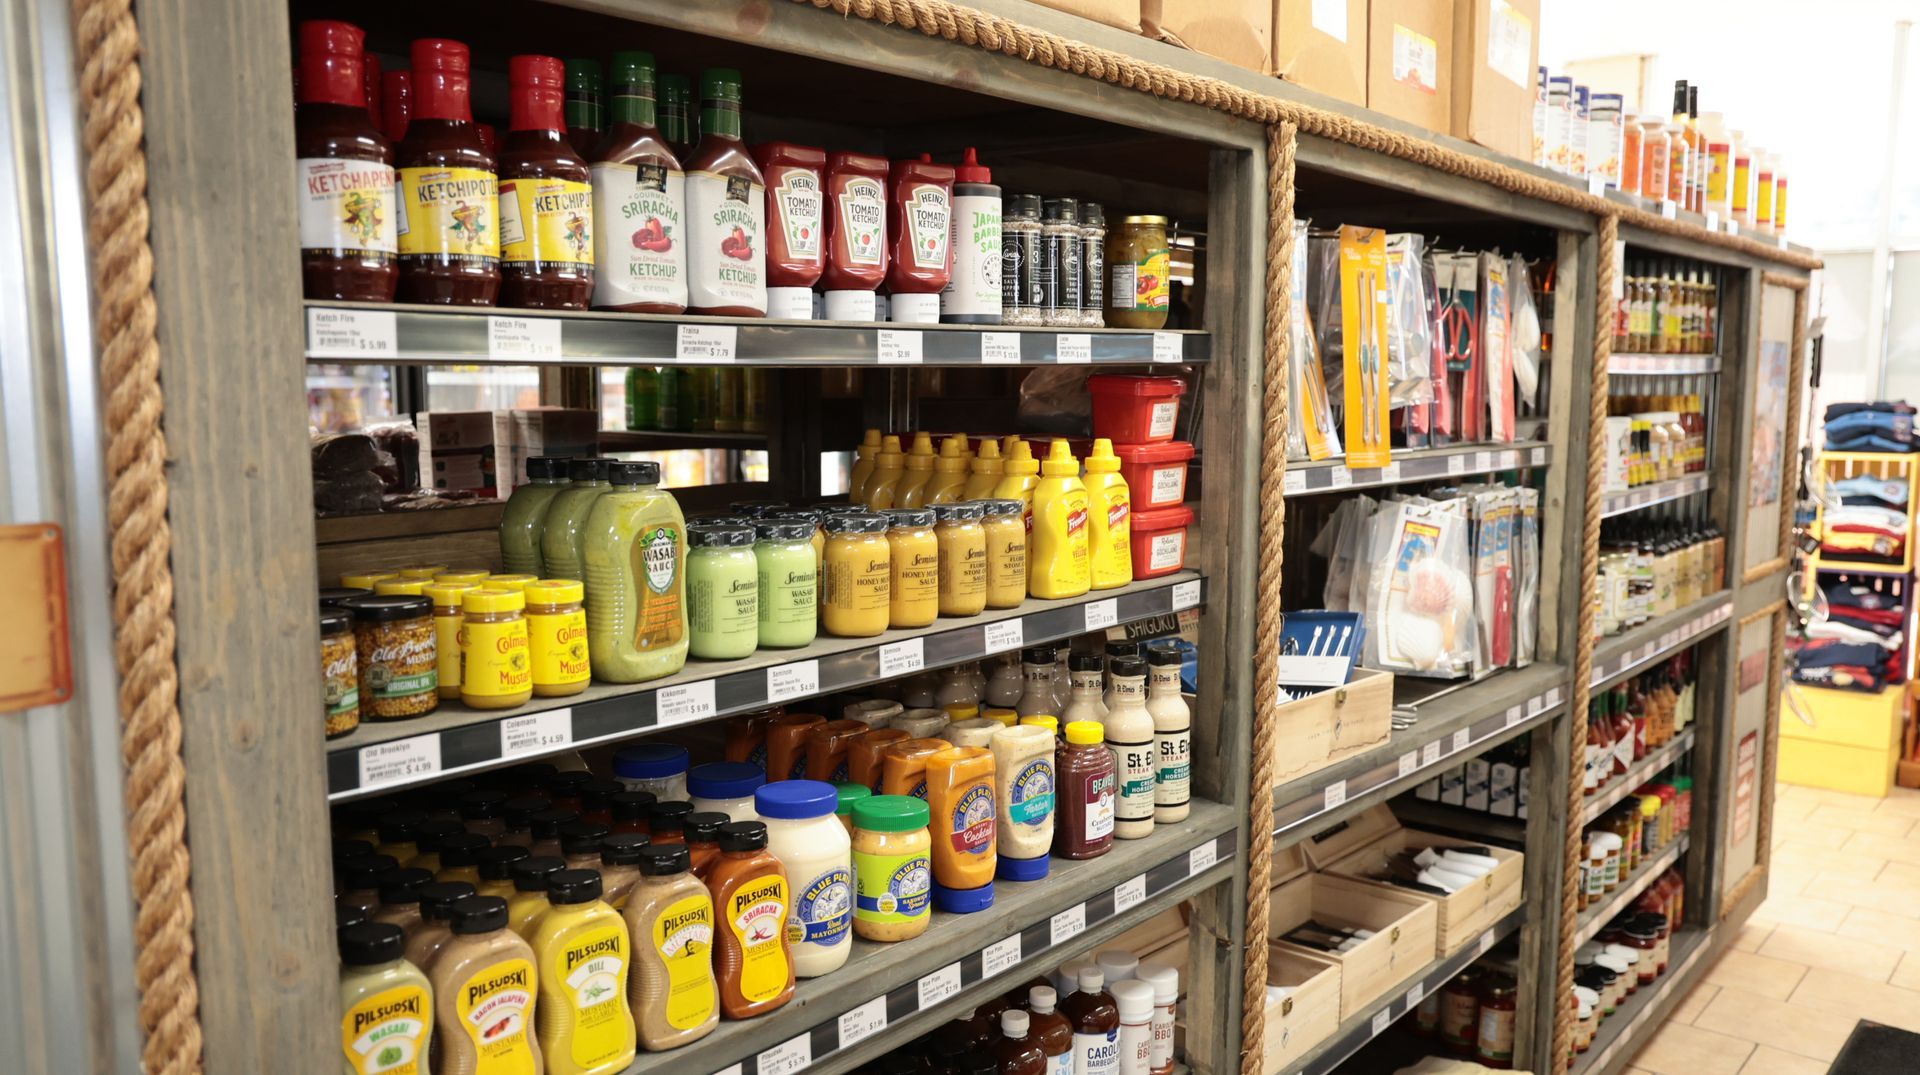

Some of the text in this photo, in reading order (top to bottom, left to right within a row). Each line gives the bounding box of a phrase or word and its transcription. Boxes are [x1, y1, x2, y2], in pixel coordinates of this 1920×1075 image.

[791, 178, 814, 191] HEINZ
[633, 191, 670, 202] GOURMET
[854, 186, 877, 199] HEINZ
[921, 193, 943, 206] HEINZ
[724, 201, 751, 213] GOURMET
[787, 196, 817, 210] TOMATO
[850, 204, 879, 216] TOMATO
[622, 200, 678, 225] SRIRACHA
[789, 207, 817, 218] KETCHUP
[852, 214, 878, 225] KETCHUP
[916, 209, 945, 222] TOMATO
[714, 209, 757, 235] SRIRACHA
[918, 220, 944, 230] KETCHUP
[1032, 250, 1039, 264] 3
[630, 263, 677, 278] KETCHUP
[719, 268, 757, 285] KETCHUP
[643, 546, 678, 562] WASABI
[648, 561, 674, 573] SAUCE
[902, 570, 925, 579] HONEY
[857, 577, 879, 586] HONEY
[1128, 614, 1176, 639] SHIGOKU
[372, 646, 398, 663] Old
[387, 677, 430, 692] ORIGINAL IPA
[507, 718, 537, 729] Colemans
[1161, 741, 1177, 755] St.
[1128, 753, 1144, 768] St.
[1018, 768, 1035, 788] BLUE
[960, 791, 978, 814] BLUE
[963, 824, 993, 843] Cocktail
[895, 863, 915, 881] BLUE
[806, 877, 832, 901] BLUE
[736, 883, 781, 913] PILSUDSKI
[744, 905, 777, 924] SRIRACHA
[664, 907, 709, 938] PILSUDSKI
[567, 936, 620, 970] PILSUDSKI
[747, 940, 778, 954] MUSTARD
[588, 960, 605, 974] DILL
[469, 968, 527, 1006] PILSUDSKI
[355, 995, 420, 1034] PILSUDSKI
[474, 1001, 497, 1021] BACON
[580, 999, 617, 1017] MUSTARD
[369, 1022, 410, 1043] WASABI
[1155, 1028, 1171, 1040] BBQ
[482, 1033, 523, 1054] MUSTARD
[1088, 1057, 1116, 1068] BARBEQUE
